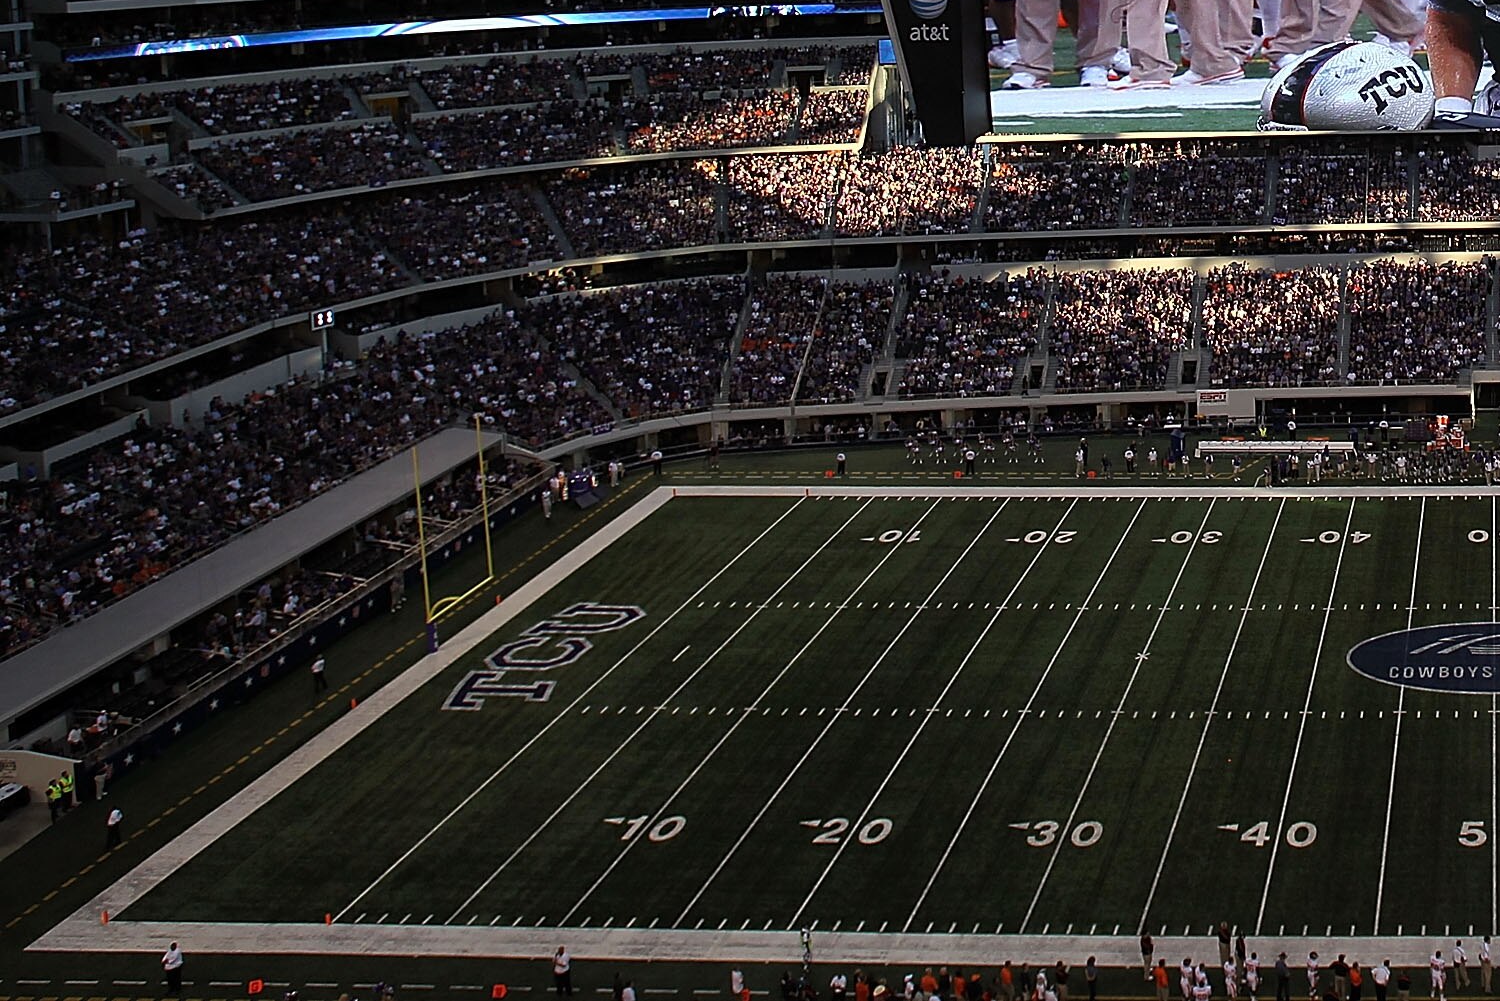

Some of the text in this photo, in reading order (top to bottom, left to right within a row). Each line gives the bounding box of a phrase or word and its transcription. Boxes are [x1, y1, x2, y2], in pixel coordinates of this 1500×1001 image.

[910, 24, 949, 41] at&t
[1358, 65, 1423, 115] TCU
[879, 529, 922, 543] 10
[1025, 529, 1078, 544] 20
[1170, 529, 1223, 544] 30
[1319, 529, 1371, 544] 40
[441, 602, 647, 711] TCU
[1389, 666, 1492, 679] COWBOYS
[622, 816, 687, 841] 10
[812, 817, 893, 844] 20
[1026, 820, 1103, 848] 30
[1240, 820, 1318, 848] 40
